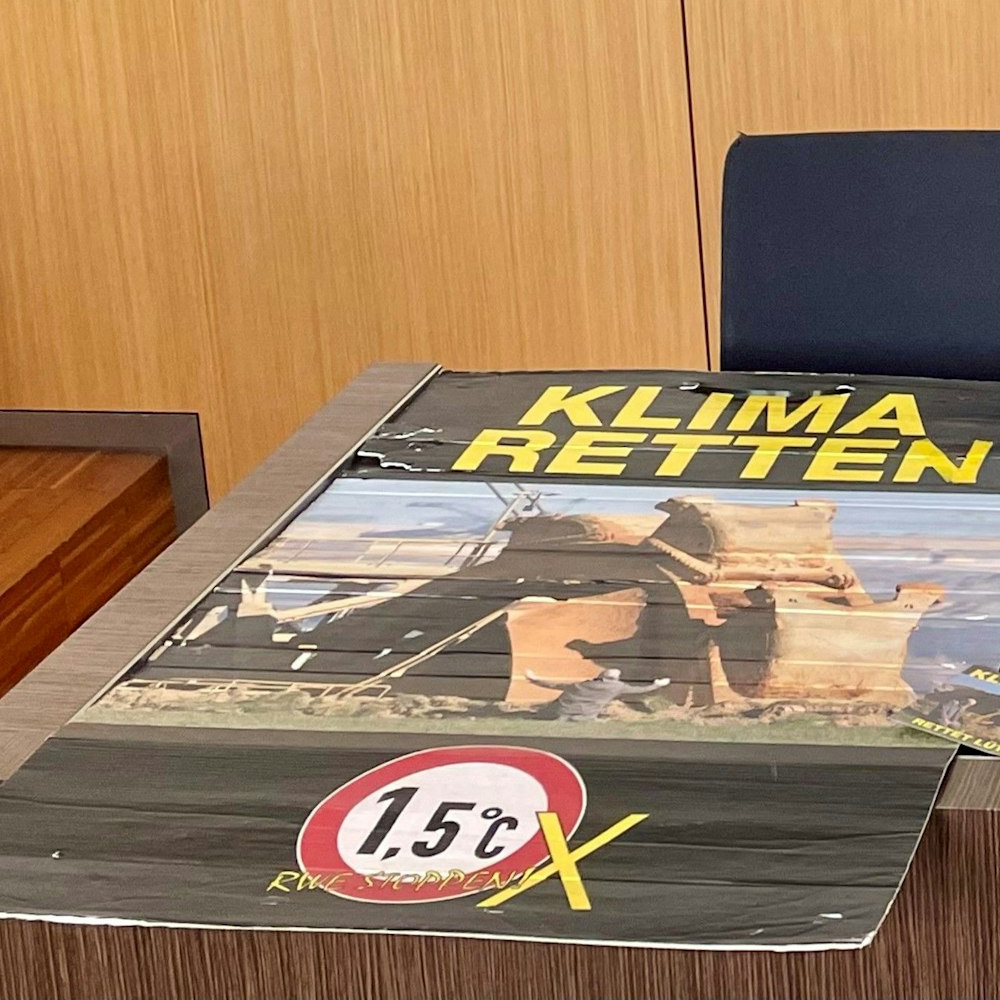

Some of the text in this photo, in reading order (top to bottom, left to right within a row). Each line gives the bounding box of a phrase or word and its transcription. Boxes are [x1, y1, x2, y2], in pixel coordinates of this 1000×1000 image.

[517, 385, 926, 437] KLIMA
[451, 429, 993, 483] RETTEN
[911, 717, 974, 742] RETTET
[266, 870, 351, 892] RWE
